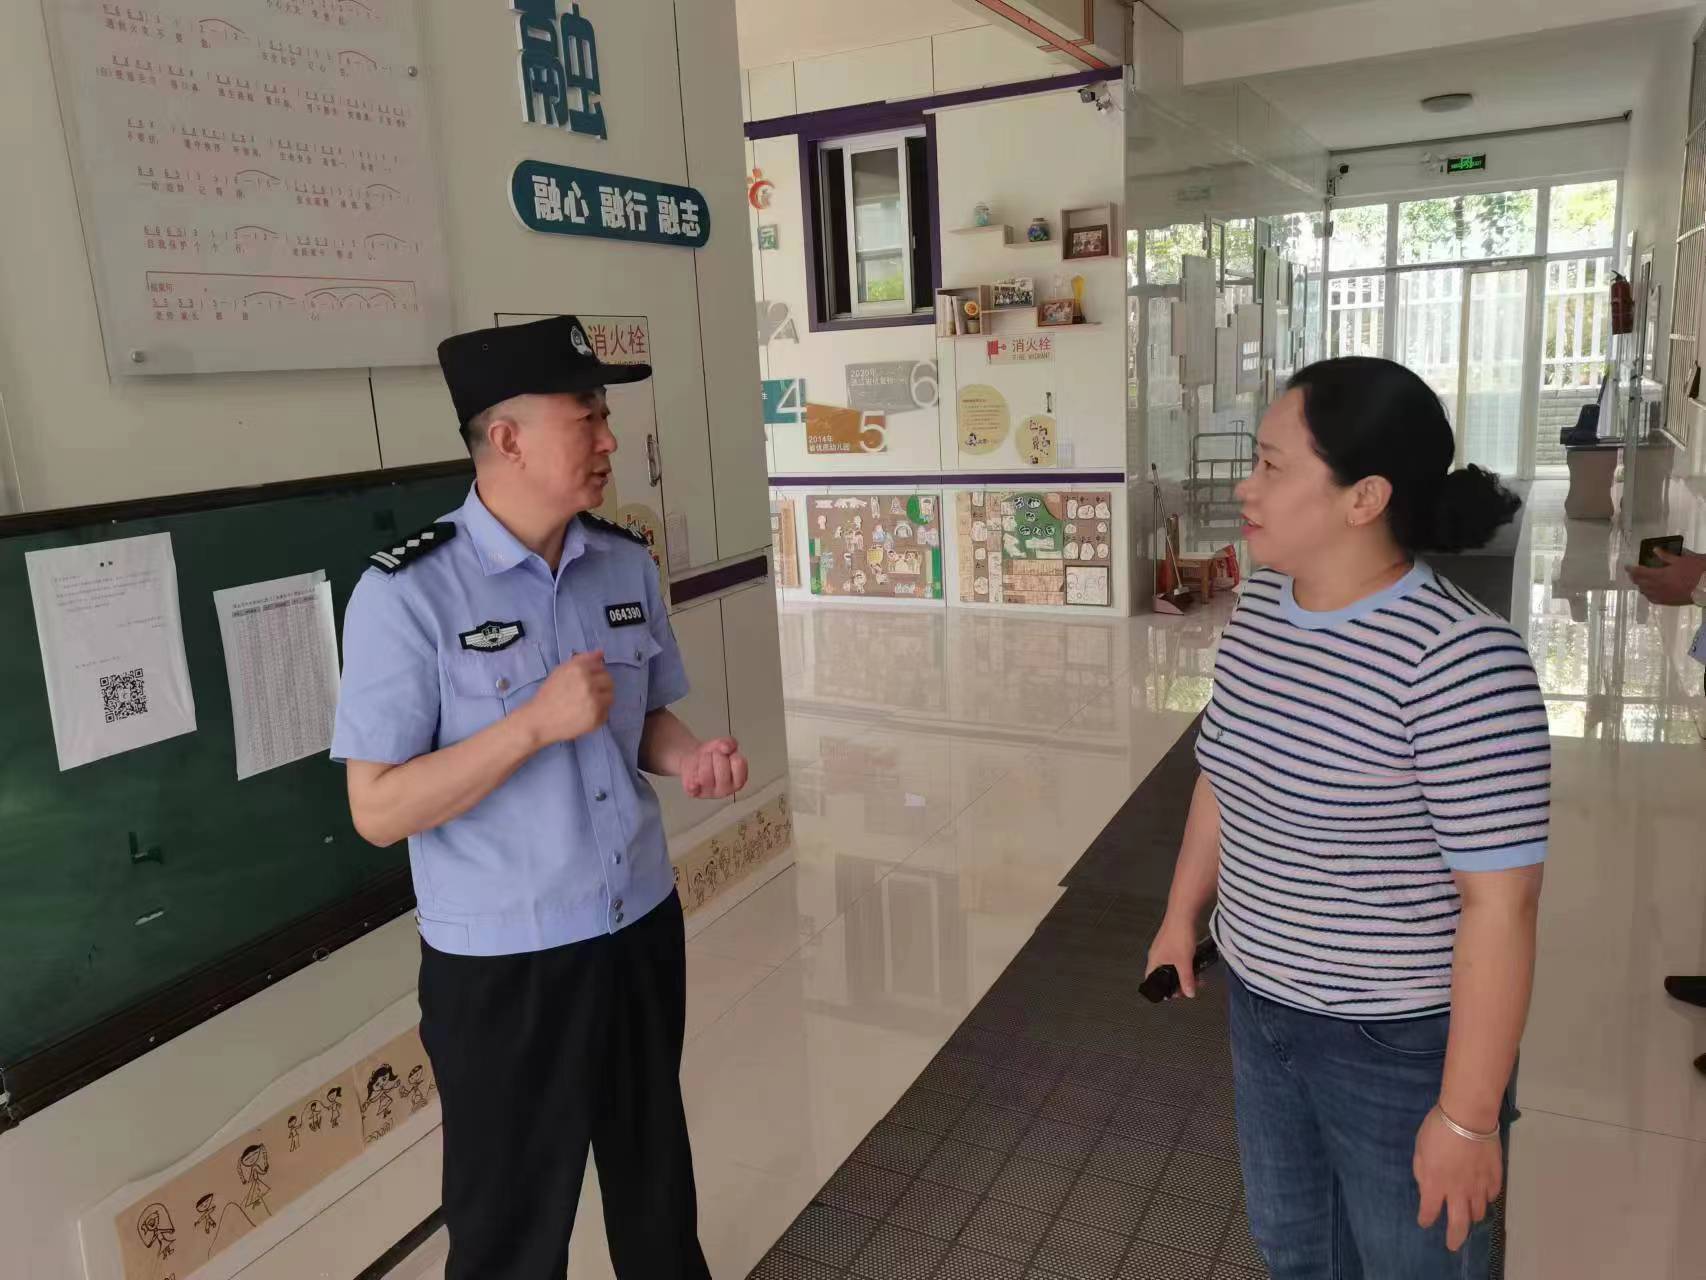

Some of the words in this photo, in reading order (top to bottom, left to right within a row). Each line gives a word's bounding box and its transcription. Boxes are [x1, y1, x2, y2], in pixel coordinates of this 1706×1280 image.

[532, 175, 590, 224] 融心
[598, 186, 649, 232] 融行
[656, 194, 702, 237] 融志
[587, 324, 648, 356] 消火栓
[1012, 336, 1053, 353] 消火栓
[775, 376, 807, 424] 4
[910, 359, 940, 410] 6
[859, 409, 888, 453] 5
[609, 606, 642, 623] 064390
